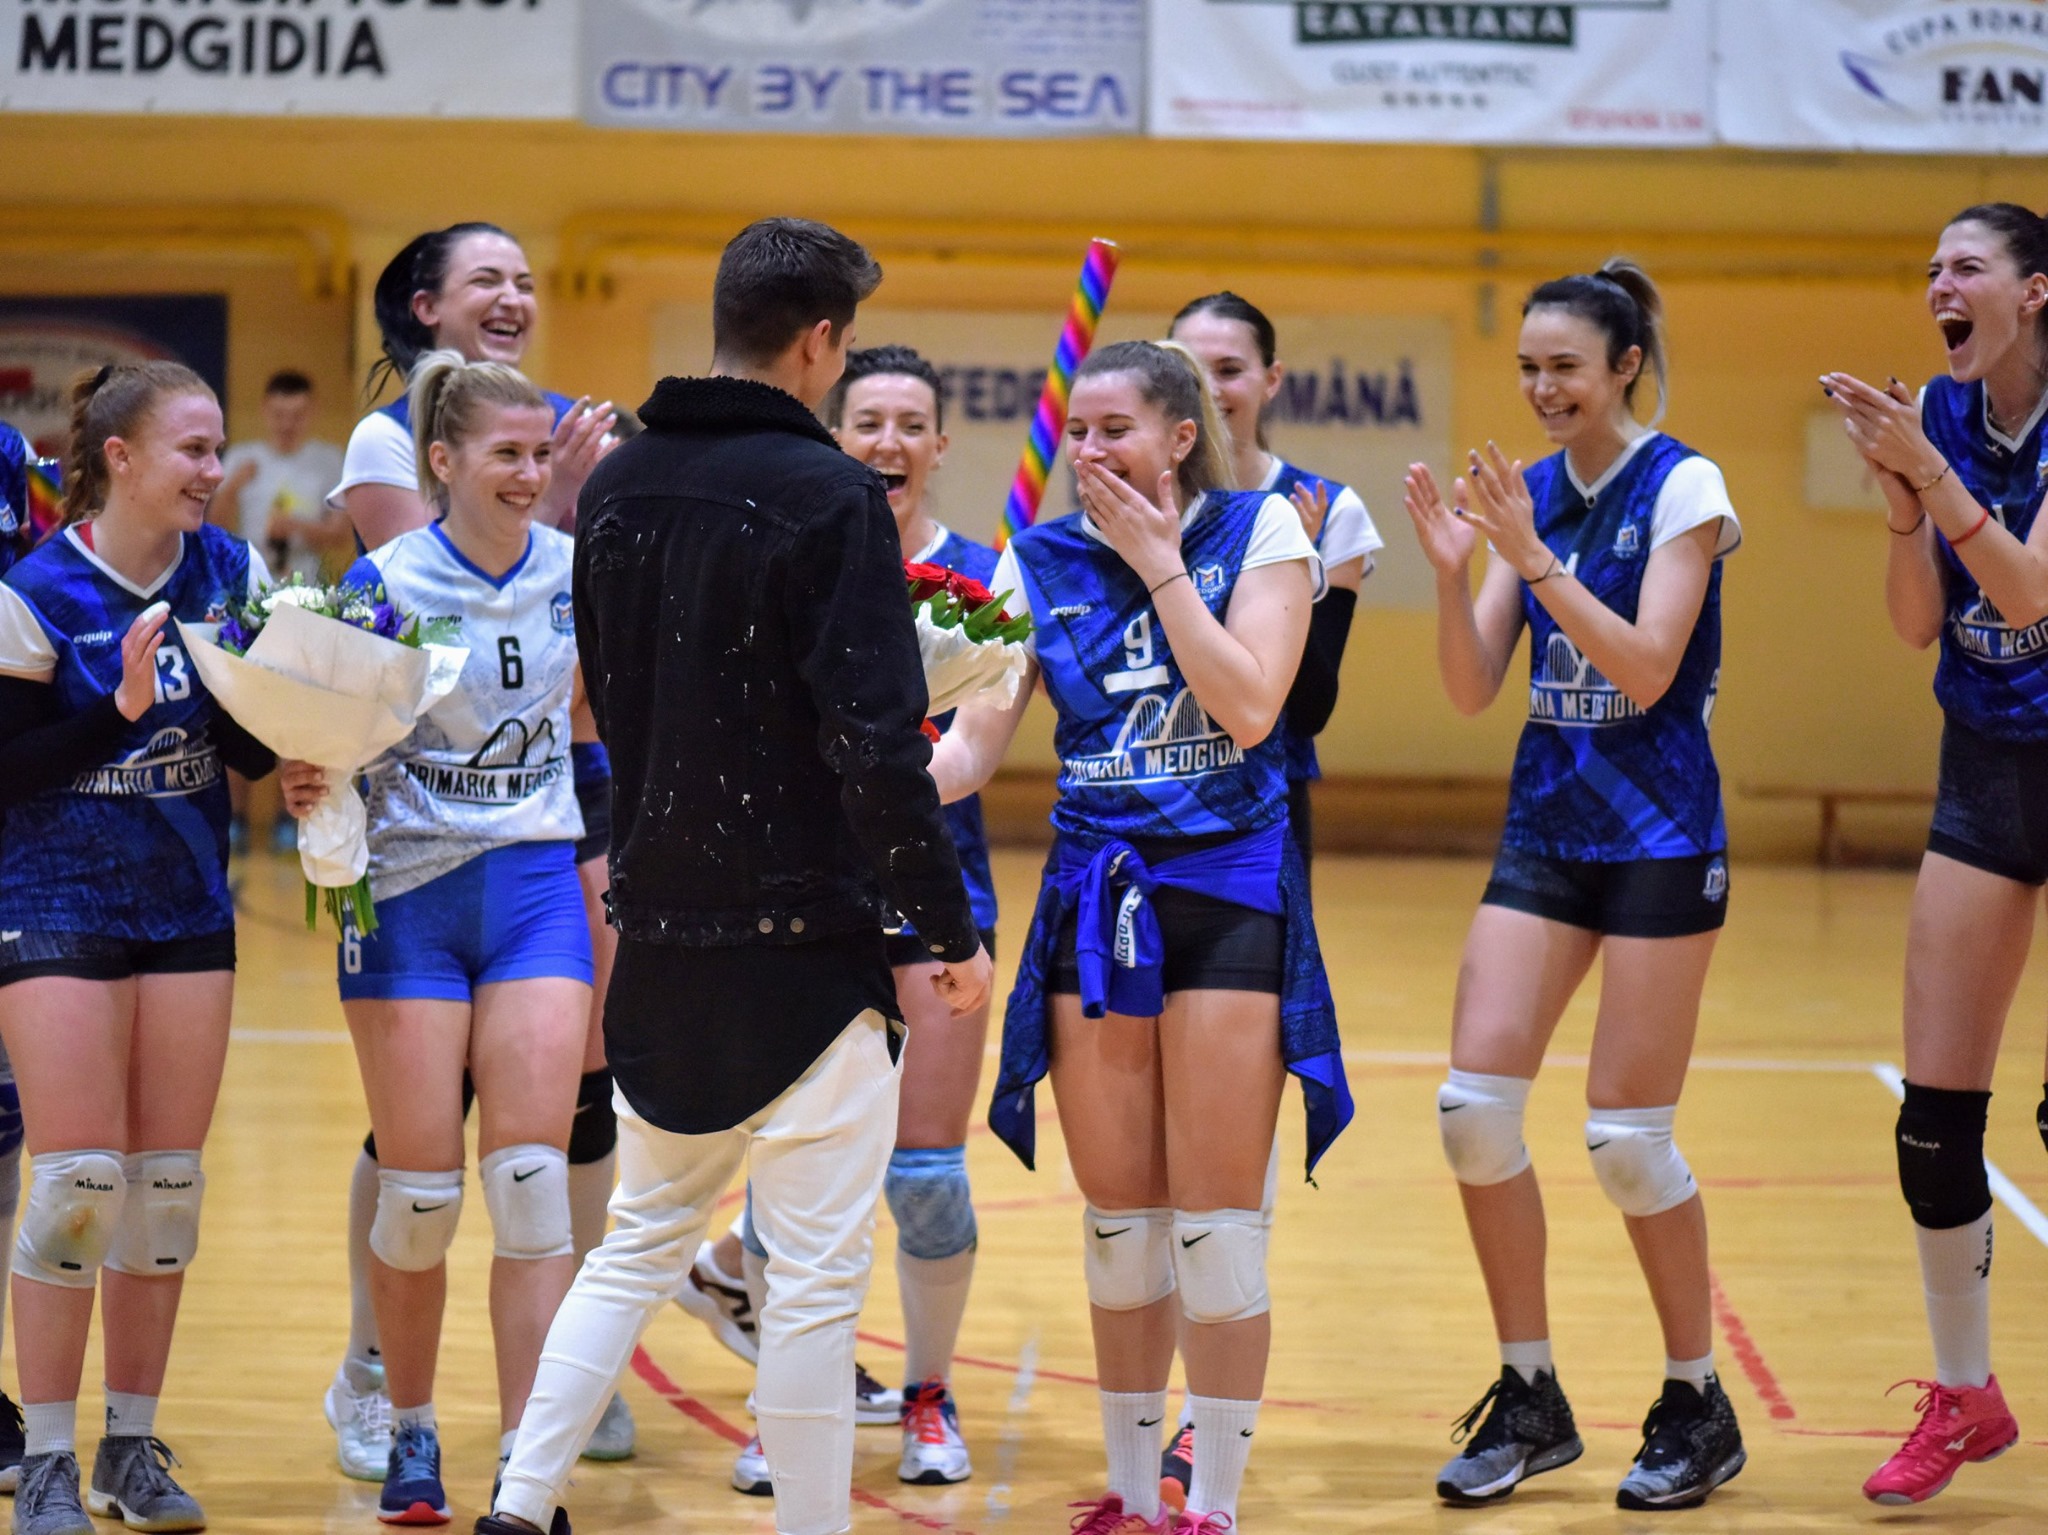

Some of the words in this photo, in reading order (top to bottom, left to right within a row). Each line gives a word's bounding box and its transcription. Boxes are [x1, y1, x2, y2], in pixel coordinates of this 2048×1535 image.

[19, 16, 385, 76] MEDGIDIA
[604, 62, 731, 108] CITY
[861, 68, 974, 115] THE
[1942, 65, 2045, 104] FAN
[1050, 604, 1092, 616] equip
[73, 630, 112, 644] equip
[1123, 611, 1153, 670] 9
[498, 636, 524, 690] 6
[344, 924, 362, 974] 6
[75, 1177, 113, 1191] MIKASA
[153, 1177, 193, 1190] MIKASA
